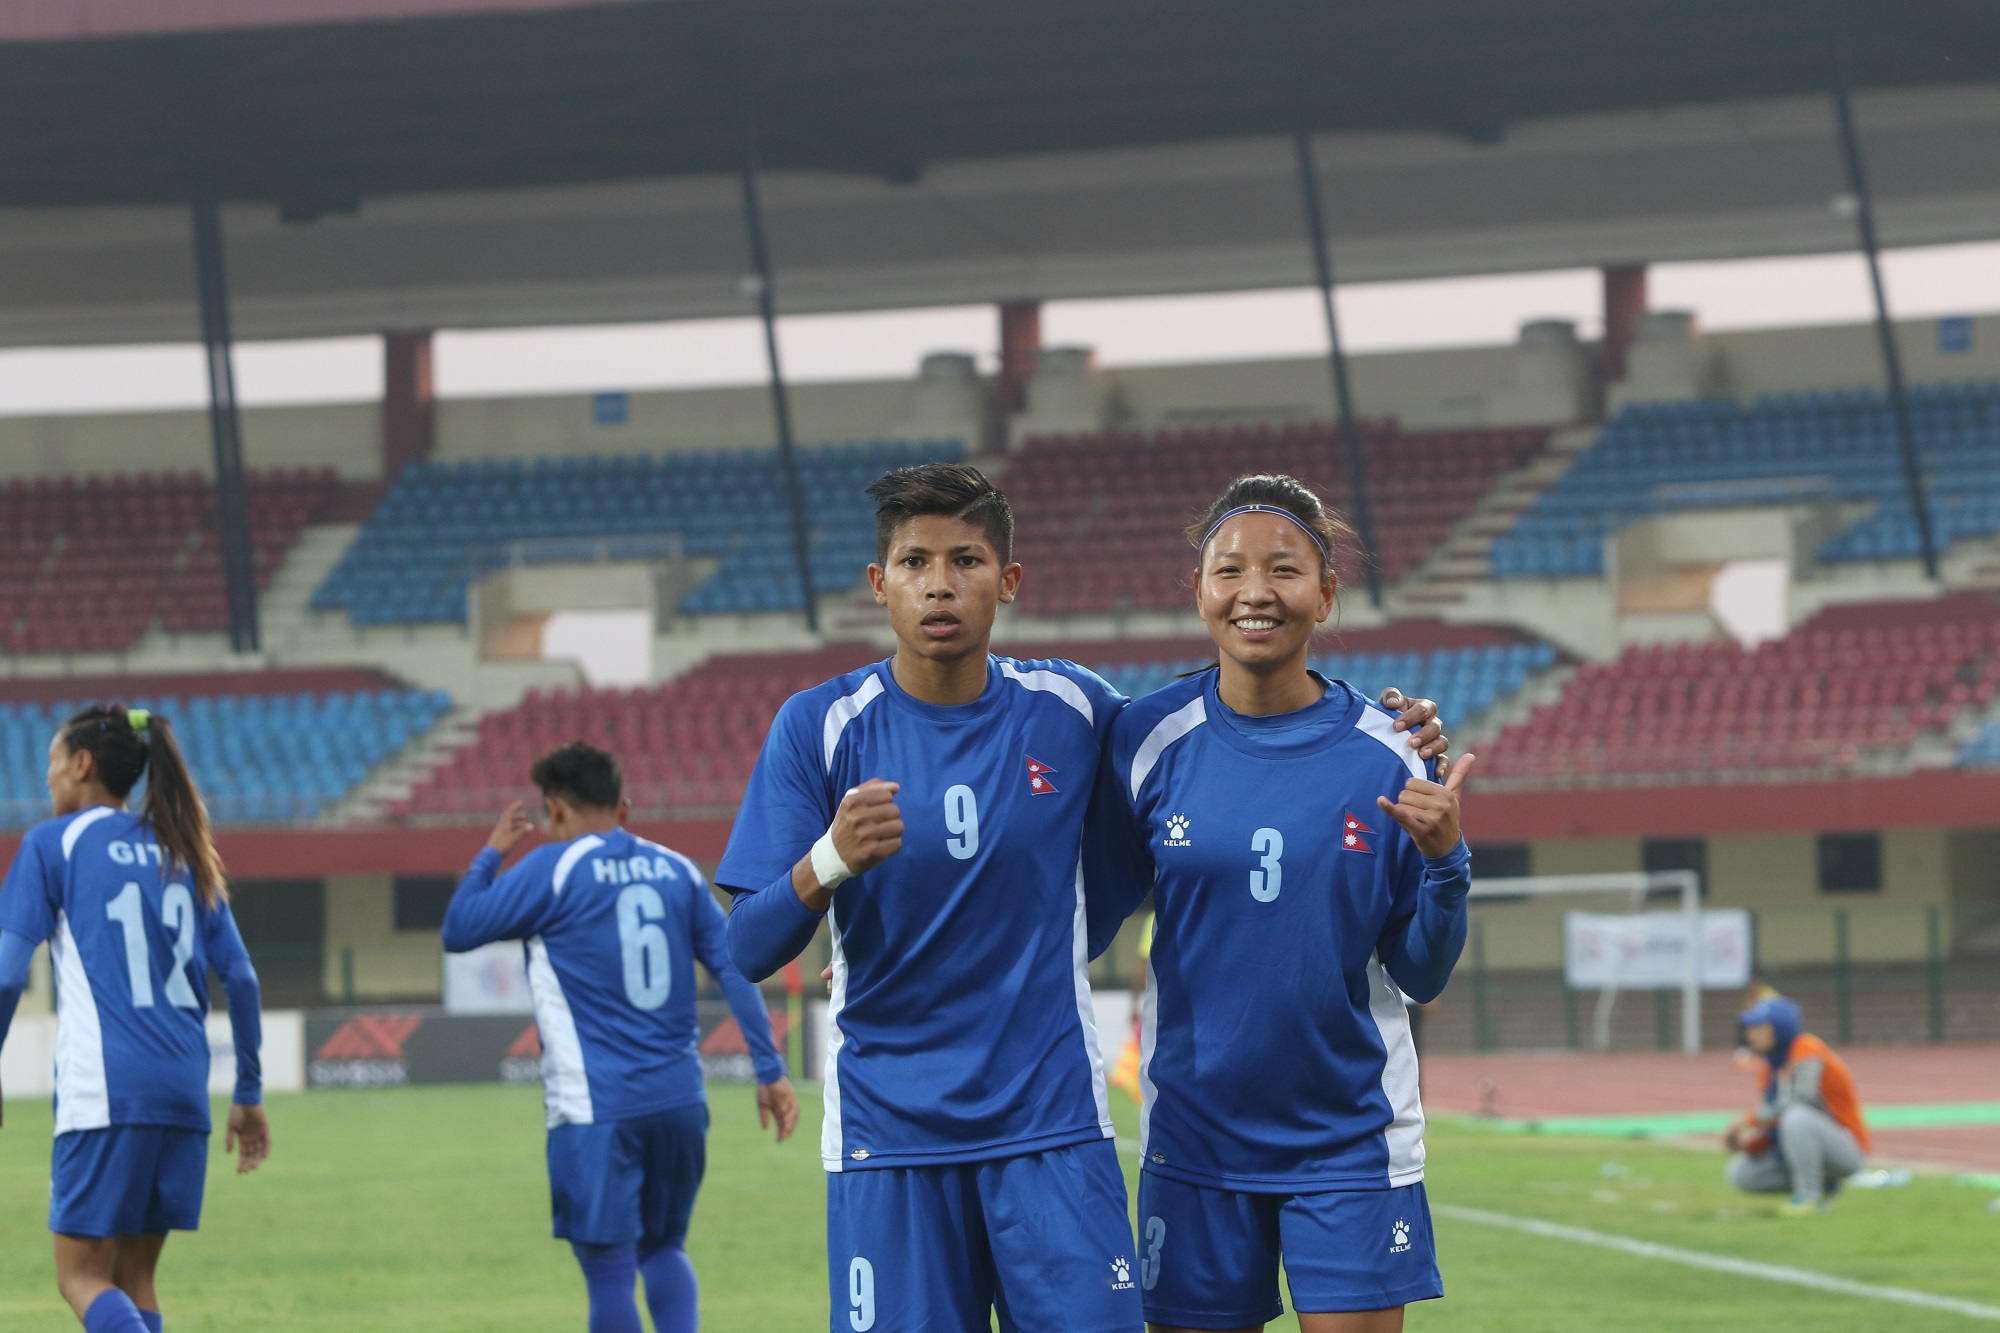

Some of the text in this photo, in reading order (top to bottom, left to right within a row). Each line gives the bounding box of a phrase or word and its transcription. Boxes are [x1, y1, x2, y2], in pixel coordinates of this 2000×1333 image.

[107, 840, 190, 873] GIT
[944, 784, 979, 860] 9
[1164, 839, 1191, 847] KELME
[592, 856, 677, 885] HIRA
[1250, 827, 1284, 903] 3
[106, 882, 200, 1008] 12
[617, 883, 671, 1010] 6
[1142, 1216, 1166, 1291] 3
[849, 1256, 876, 1332] 9
